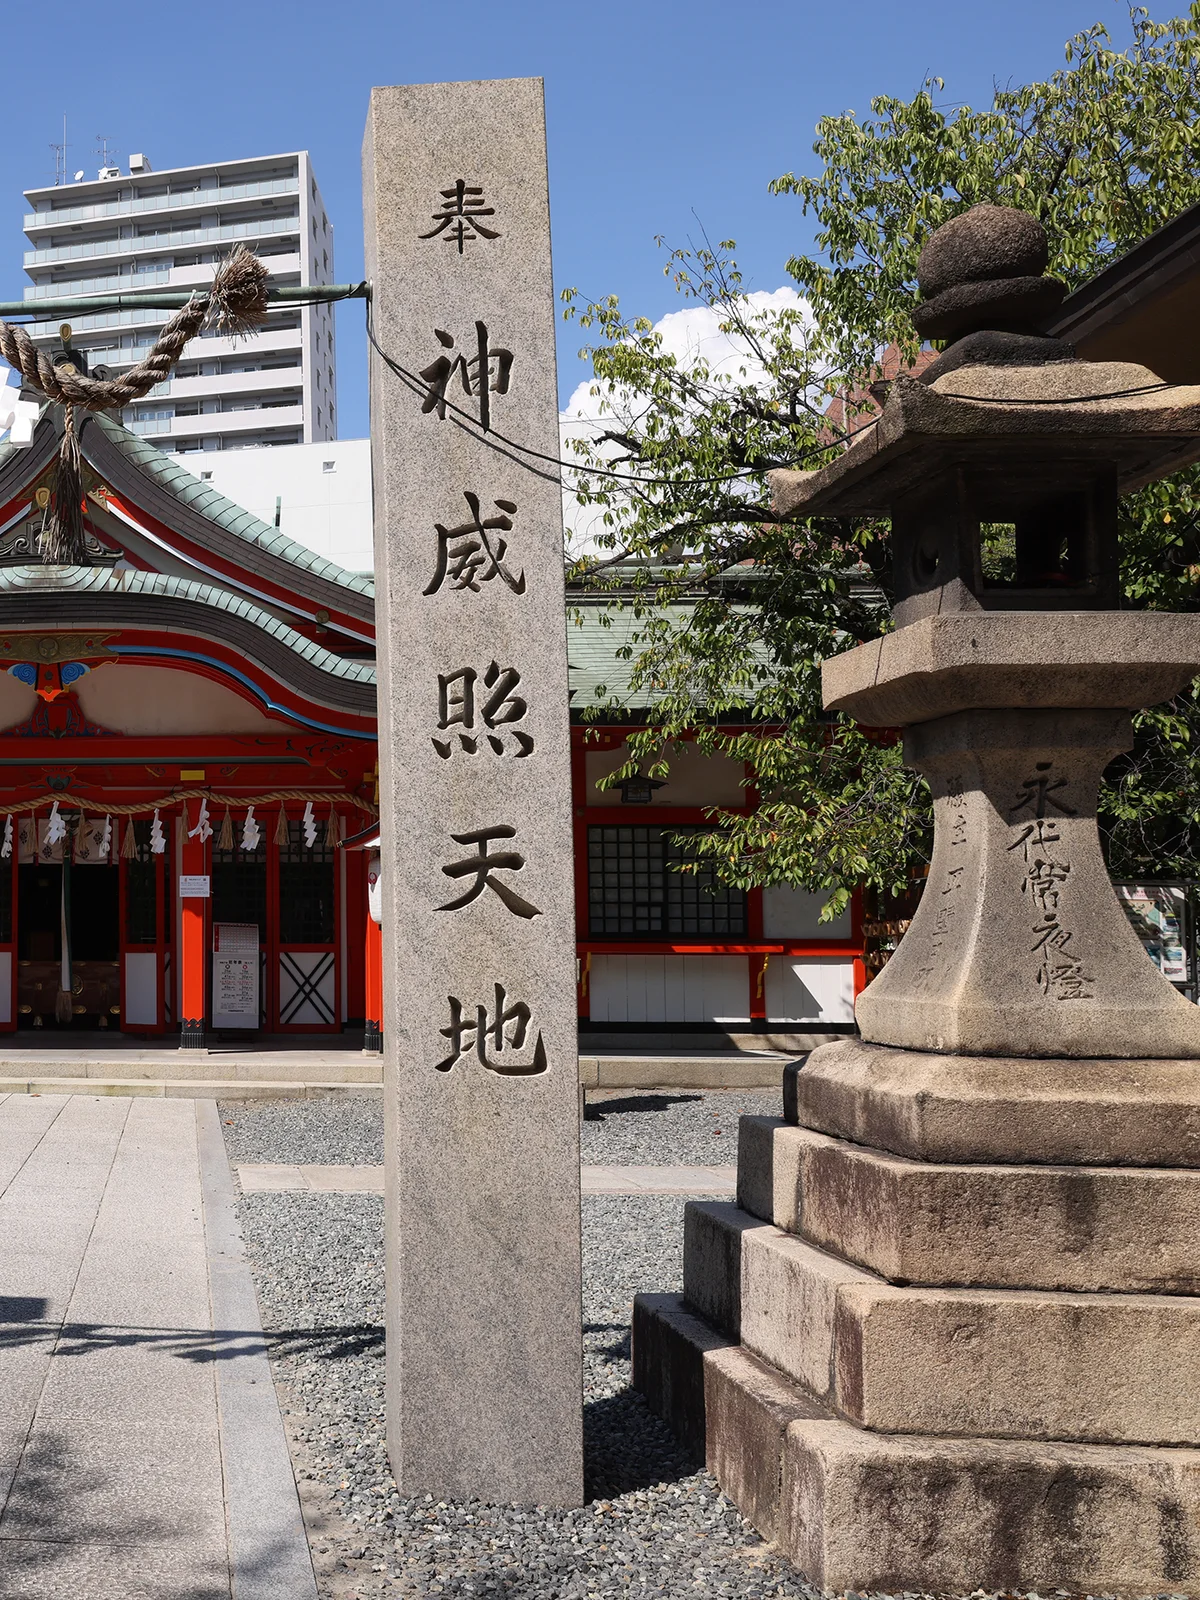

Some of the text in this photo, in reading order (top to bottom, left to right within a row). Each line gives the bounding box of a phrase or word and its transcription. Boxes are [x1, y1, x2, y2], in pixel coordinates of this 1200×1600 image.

[418, 179, 547, 1077] 奉神威照天地
